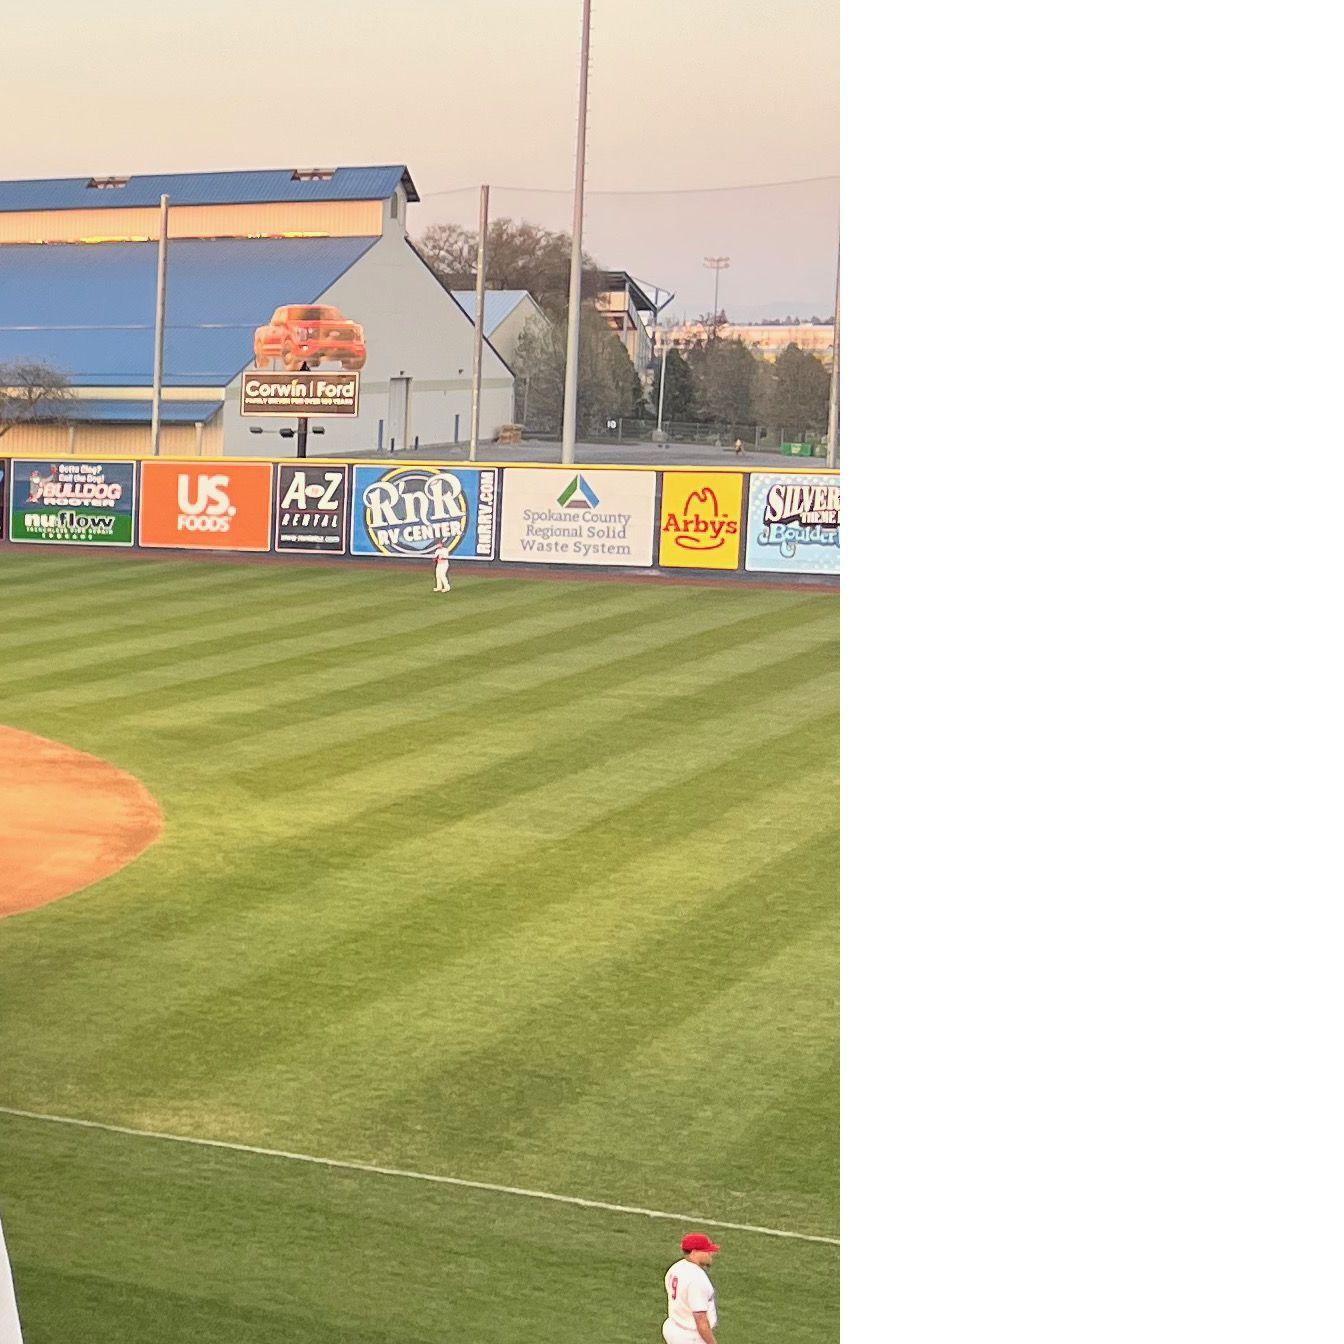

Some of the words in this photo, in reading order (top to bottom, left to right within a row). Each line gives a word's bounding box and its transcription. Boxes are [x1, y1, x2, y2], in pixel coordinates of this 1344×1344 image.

[245, 379, 307, 397] Corwin
[317, 380, 355, 397] Ford
[43, 482, 123, 500] BULLDOG
[177, 515, 230, 532] FOODS
[282, 513, 338, 528] RENTAL
[523, 509, 580, 524] Spokane
[582, 511, 631, 527] County
[662, 513, 738, 539] Arby's
[377, 526, 400, 546] RV
[403, 520, 463, 542] CENTER
[525, 524, 583, 540] Regional
[587, 525, 628, 539] Solid
[520, 538, 569, 553] Waste
[573, 541, 631, 557] System
